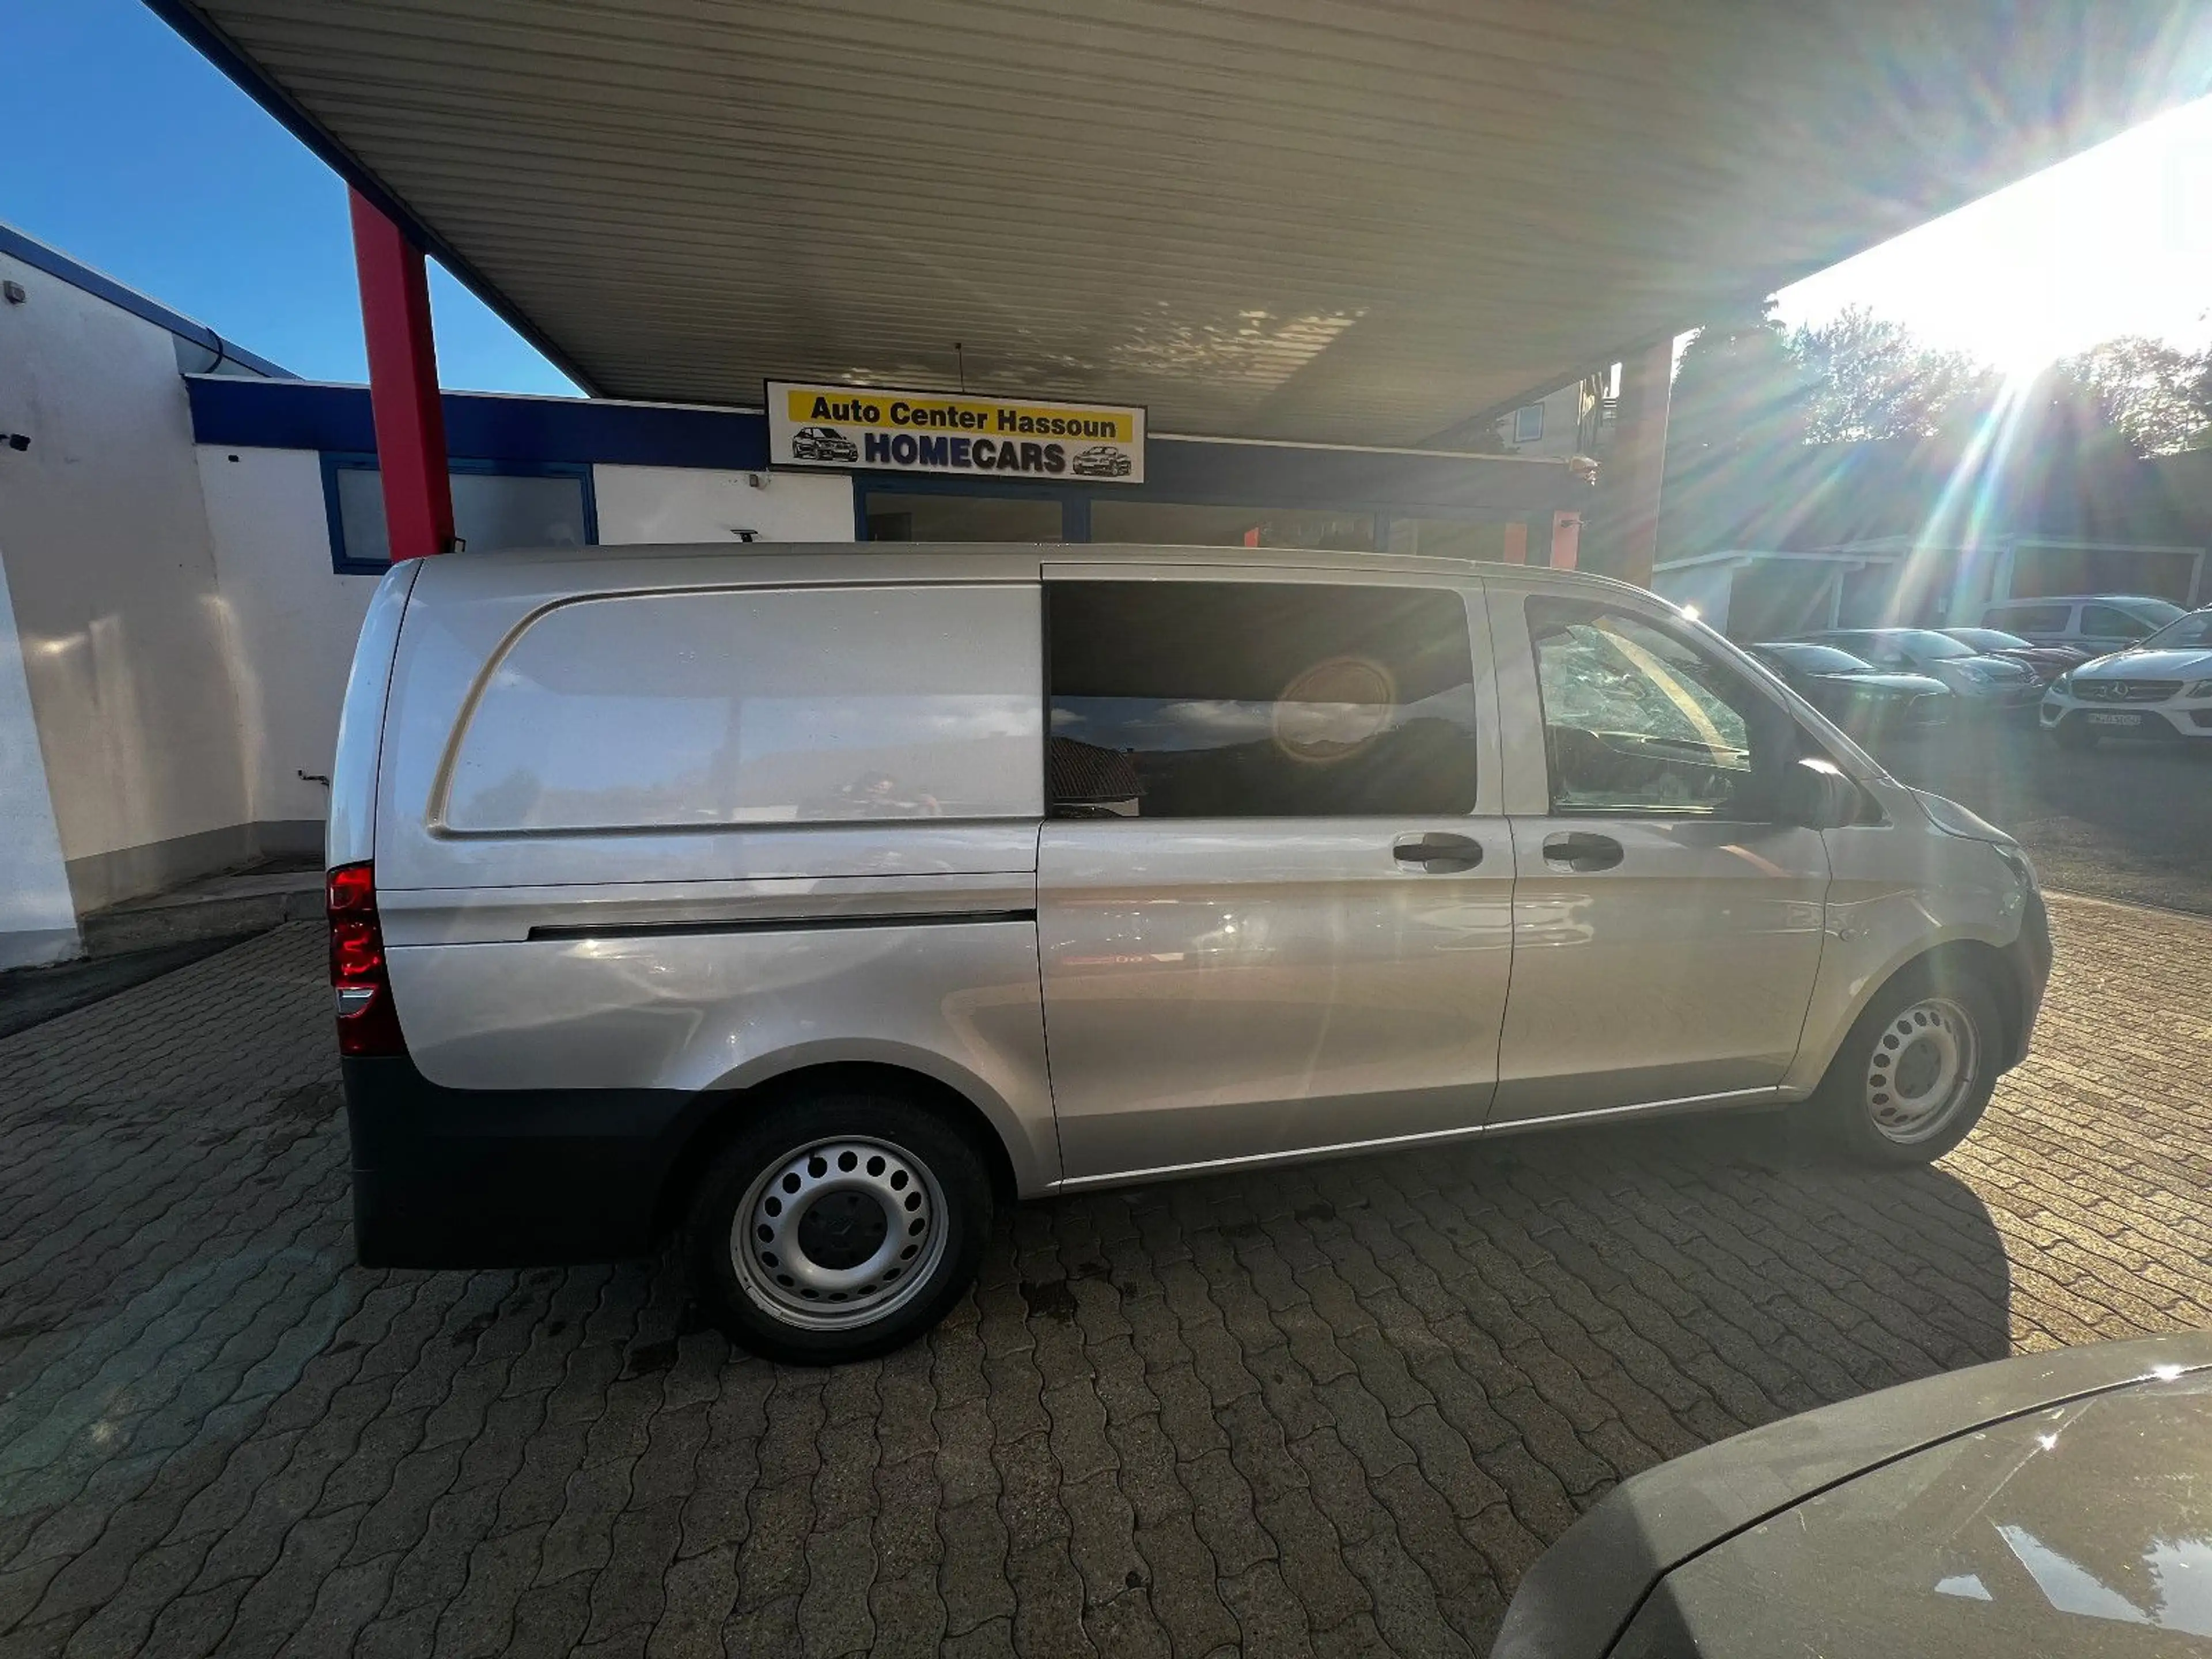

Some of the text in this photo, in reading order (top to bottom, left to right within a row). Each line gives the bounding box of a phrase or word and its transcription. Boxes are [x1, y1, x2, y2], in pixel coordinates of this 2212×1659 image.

[810, 396, 1116, 438] Auto Center Hassoun
[864, 432, 1066, 473] HOMECARS
